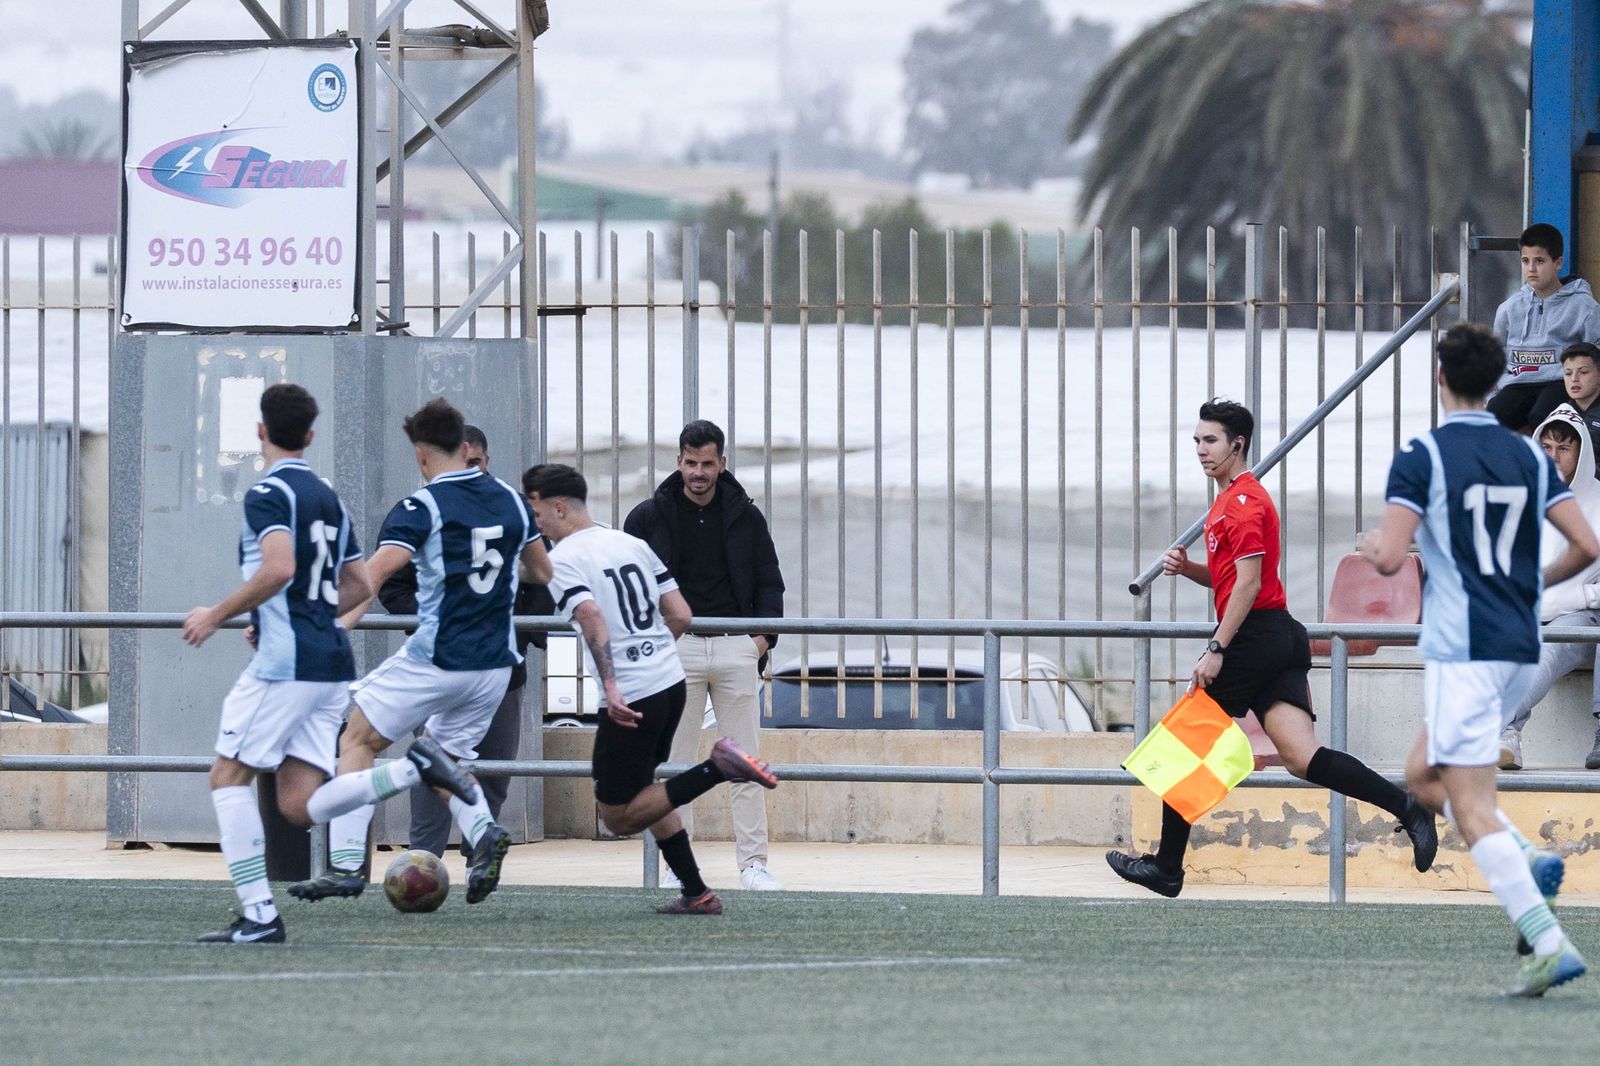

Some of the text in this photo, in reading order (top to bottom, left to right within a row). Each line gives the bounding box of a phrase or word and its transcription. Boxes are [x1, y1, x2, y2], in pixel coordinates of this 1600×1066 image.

[201, 145, 348, 188] SEGURA
[148, 237, 343, 266] 950 34 96 40
[142, 275, 342, 292] www.instalacionessegura.es
[1512, 351, 1552, 363] NORWAY
[1463, 484, 1528, 576] 17
[467, 525, 504, 594] 5
[603, 563, 655, 634] 10
